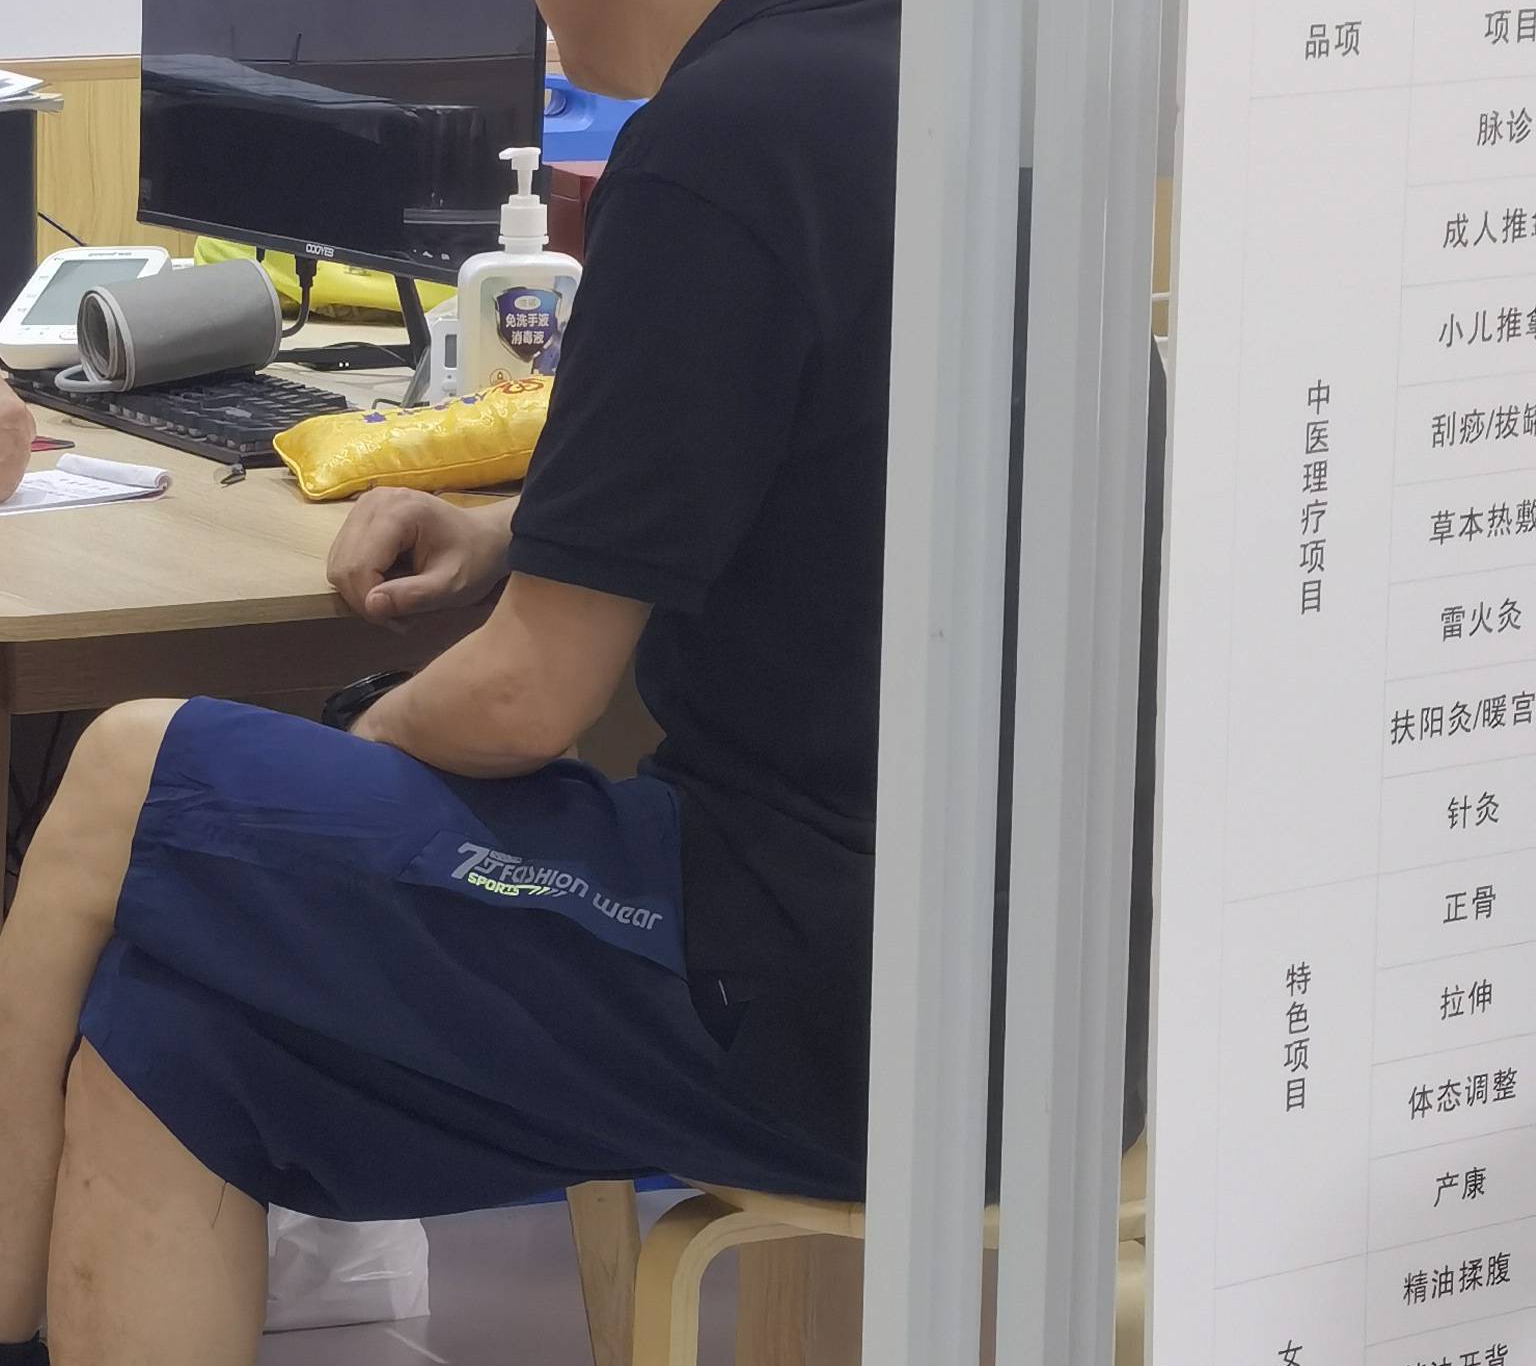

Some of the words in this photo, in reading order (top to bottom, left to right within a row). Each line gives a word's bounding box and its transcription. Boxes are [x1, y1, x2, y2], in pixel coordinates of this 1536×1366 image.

[1304, 20, 1362, 61] 品项
[1483, 8, 1536, 46] 项目
[1476, 106, 1533, 147] 脉诊
[1442, 207, 1536, 249] 成人推
[1298, 378, 1331, 616] 中医理疗项目
[1428, 498, 1536, 546] 草本热敷
[1440, 597, 1522, 643] 雷火灸
[1389, 690, 1536, 746] 扶阳灸/暖宫
[1447, 790, 1500, 830] 针灸
[1442, 884, 1497, 924] 正骨
[1439, 978, 1493, 1021] 拉伸
[1283, 960, 1312, 1113] 特色项目
[1407, 1066, 1518, 1121] 体态调整
[1433, 1166, 1487, 1208] 产康
[1402, 1251, 1511, 1307] 精油揉腹
